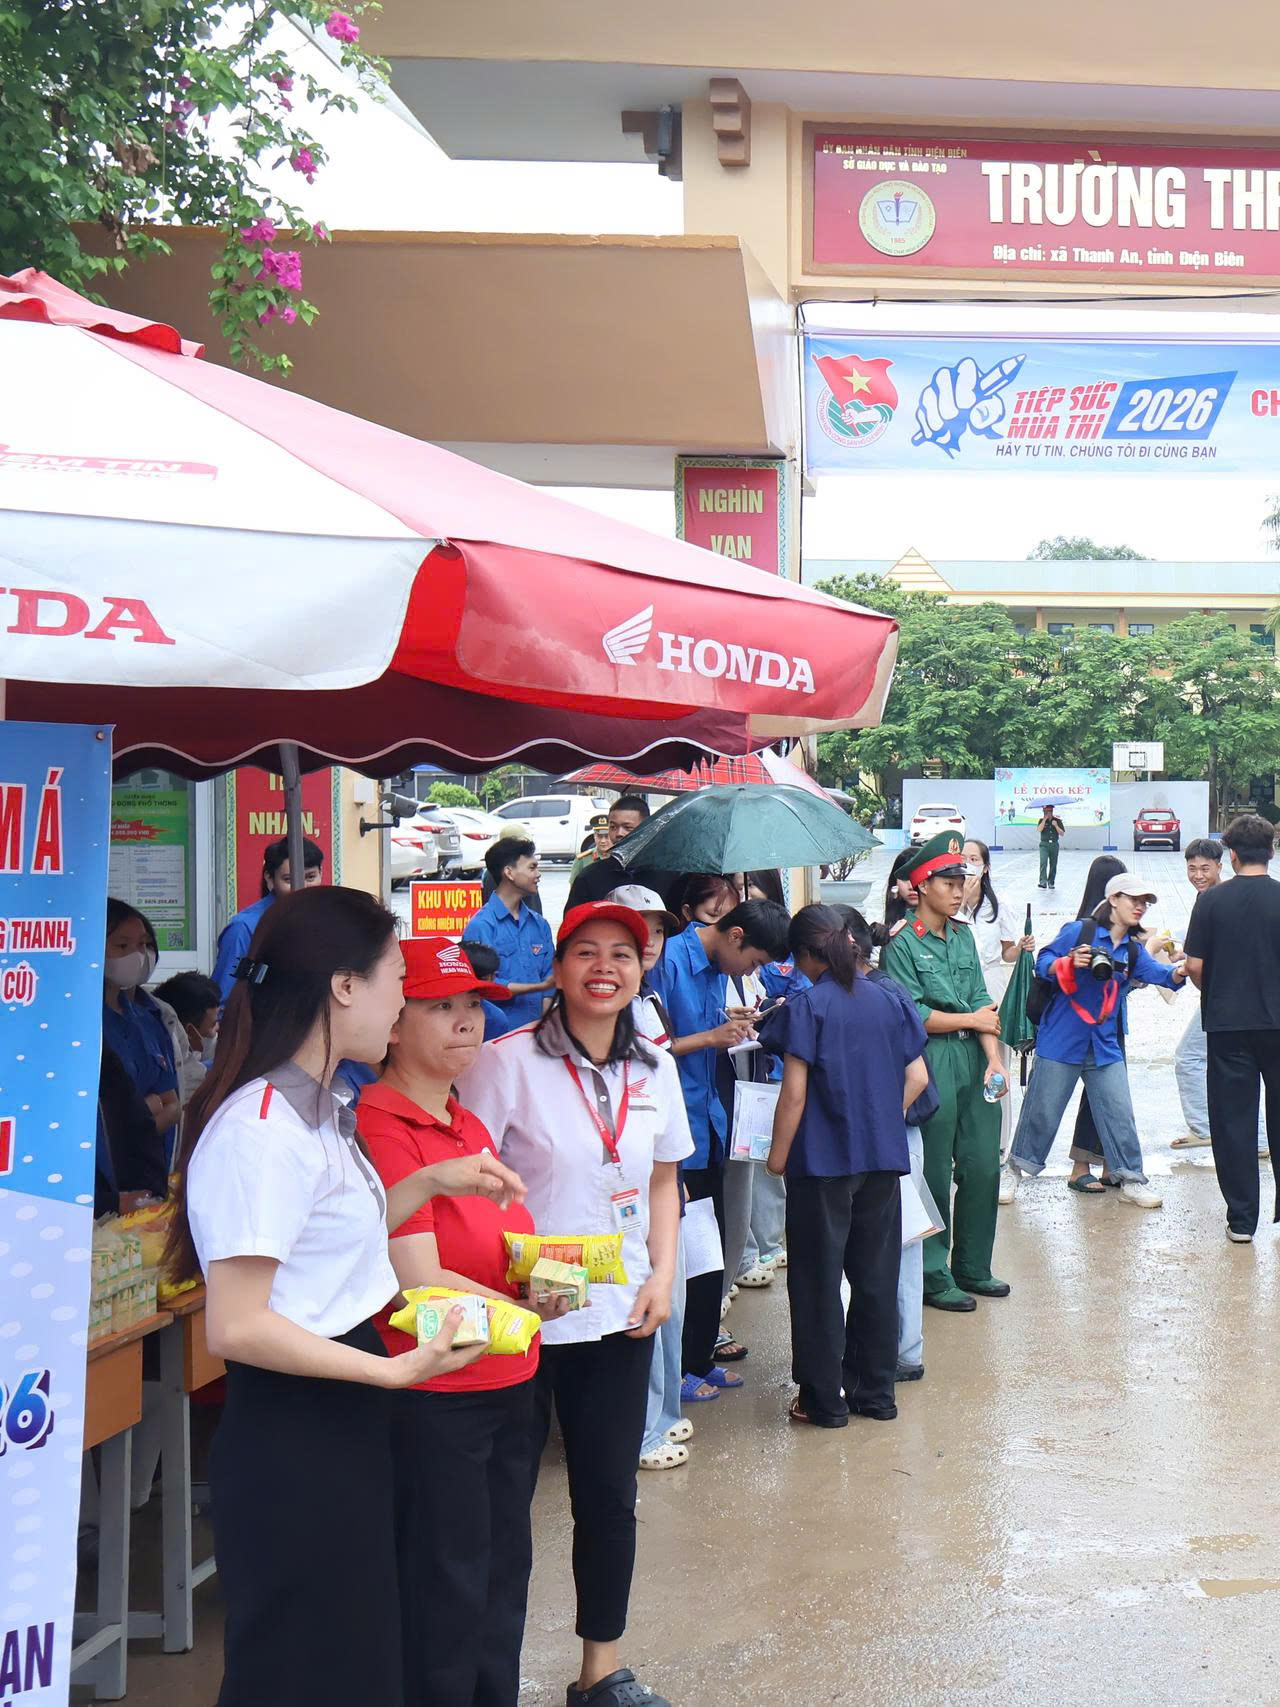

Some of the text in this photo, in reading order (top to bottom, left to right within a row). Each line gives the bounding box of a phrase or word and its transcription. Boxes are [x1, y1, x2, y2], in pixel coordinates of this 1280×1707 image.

[981, 150, 1187, 229] TRƯỜNG
[1072, 248, 1114, 263] Thanh
[1119, 250, 1144, 266] An,
[1065, 414, 1105, 439] THI
[1117, 388, 1219, 432] 2026
[699, 484, 763, 513] NGHÌN
[0, 586, 176, 645] DA
[657, 631, 816, 694] HONDA
[417, 888, 482, 912] KHU VỰC TH
[12, 920, 72, 952] THANH,
[4, 965, 34, 1002] CŨ)
